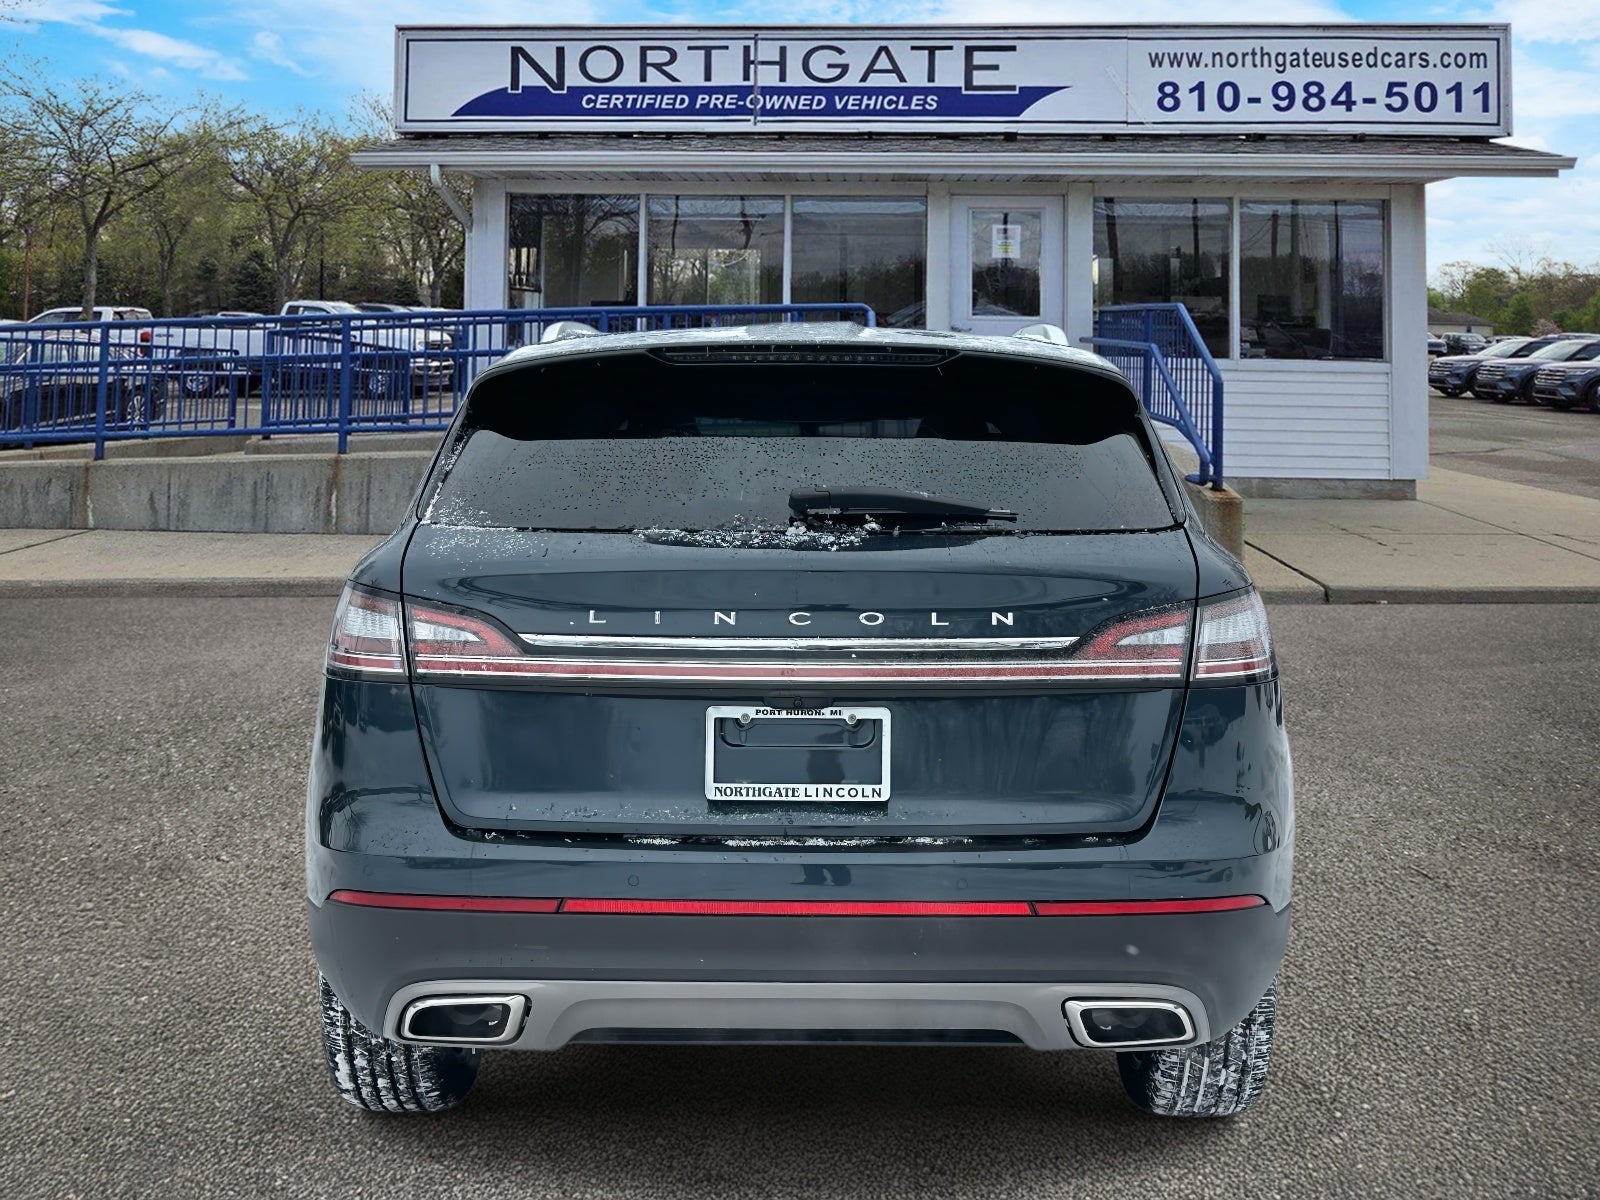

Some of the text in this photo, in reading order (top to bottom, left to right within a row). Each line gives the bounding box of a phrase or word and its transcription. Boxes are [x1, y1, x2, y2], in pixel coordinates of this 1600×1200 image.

[509, 44, 1018, 92] NORTHGATE
[1148, 47, 1489, 74] www.northgateusedcars.com
[581, 94, 938, 111] CERTIFIED PRE-OWNED VEHICLES
[1156, 80, 1491, 113] 810-984-5011
[588, 610, 1014, 626] LINCOLN
[713, 785, 882, 798] NORTHGATE LINCOLN
